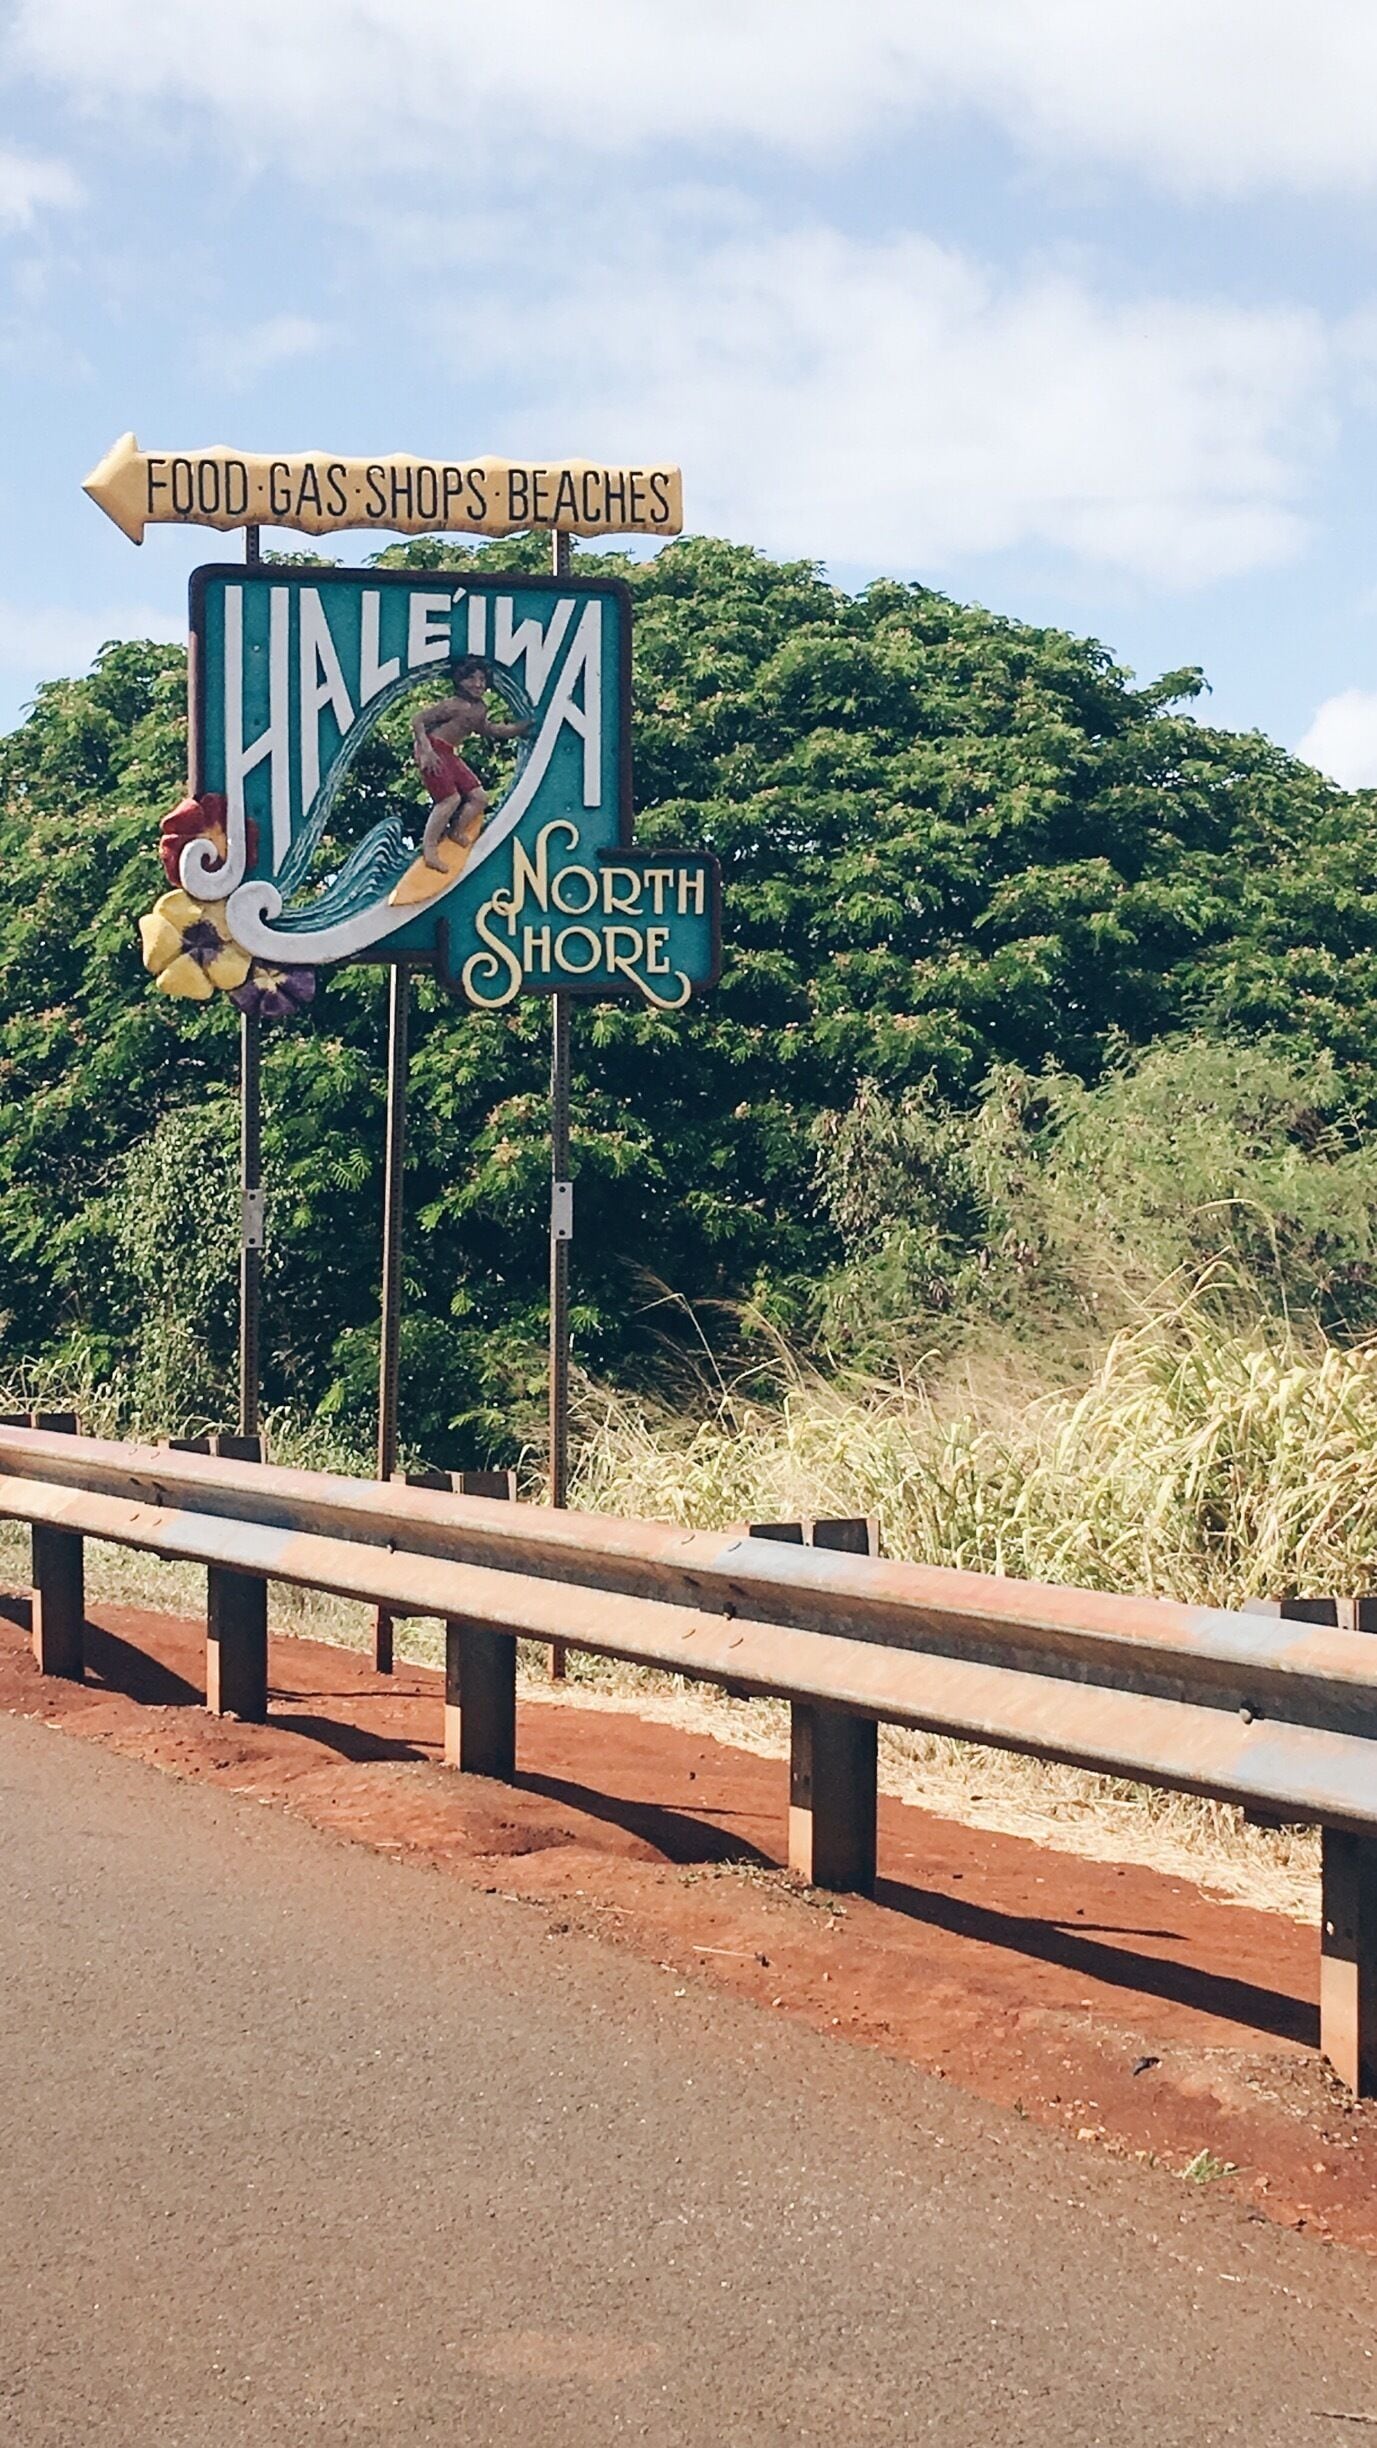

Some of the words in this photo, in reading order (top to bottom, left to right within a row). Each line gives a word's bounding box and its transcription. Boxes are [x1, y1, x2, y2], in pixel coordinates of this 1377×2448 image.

[147, 459, 248, 514] FOOD
[270, 463, 347, 517] GAS
[366, 466, 488, 520] SHOPS
[508, 469, 670, 523] BEACHES
[491, 819, 705, 916] NORTH
[462, 899, 692, 1009] SHORE
